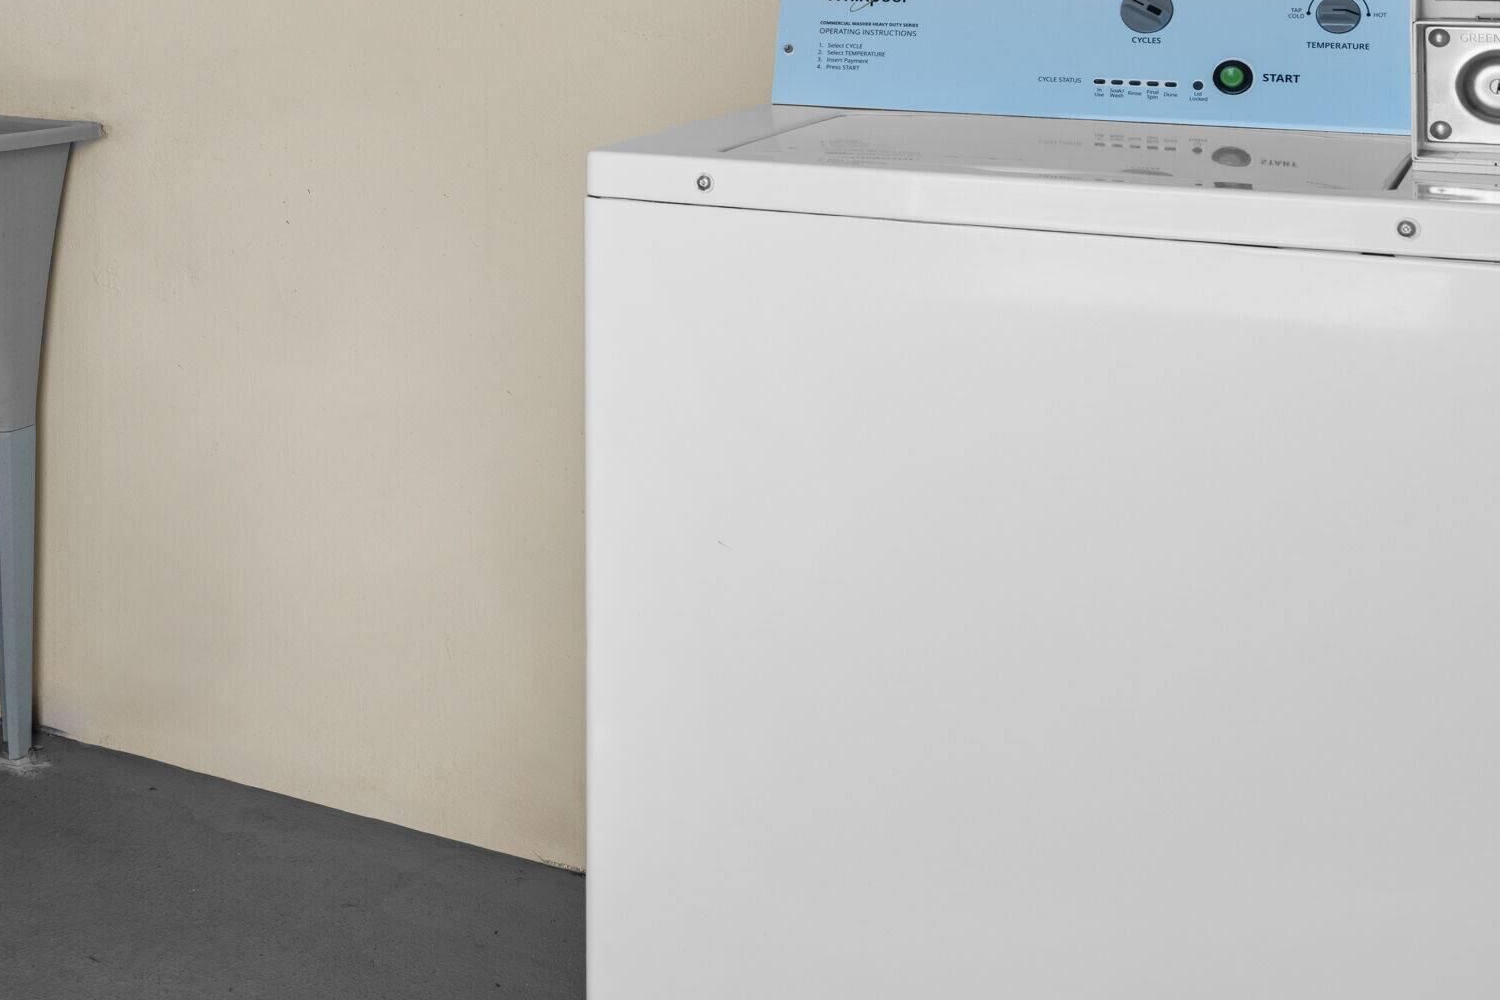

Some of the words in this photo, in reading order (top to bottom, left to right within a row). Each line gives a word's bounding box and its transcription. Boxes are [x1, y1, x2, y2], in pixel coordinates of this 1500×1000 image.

[819, 27, 861, 35] OPERATING
[862, 29, 917, 37] INSTRUCTIONS
[1131, 36, 1161, 44] CYCLES
[1306, 41, 1370, 50] TEMPERATURE
[1262, 73, 1300, 83] START
